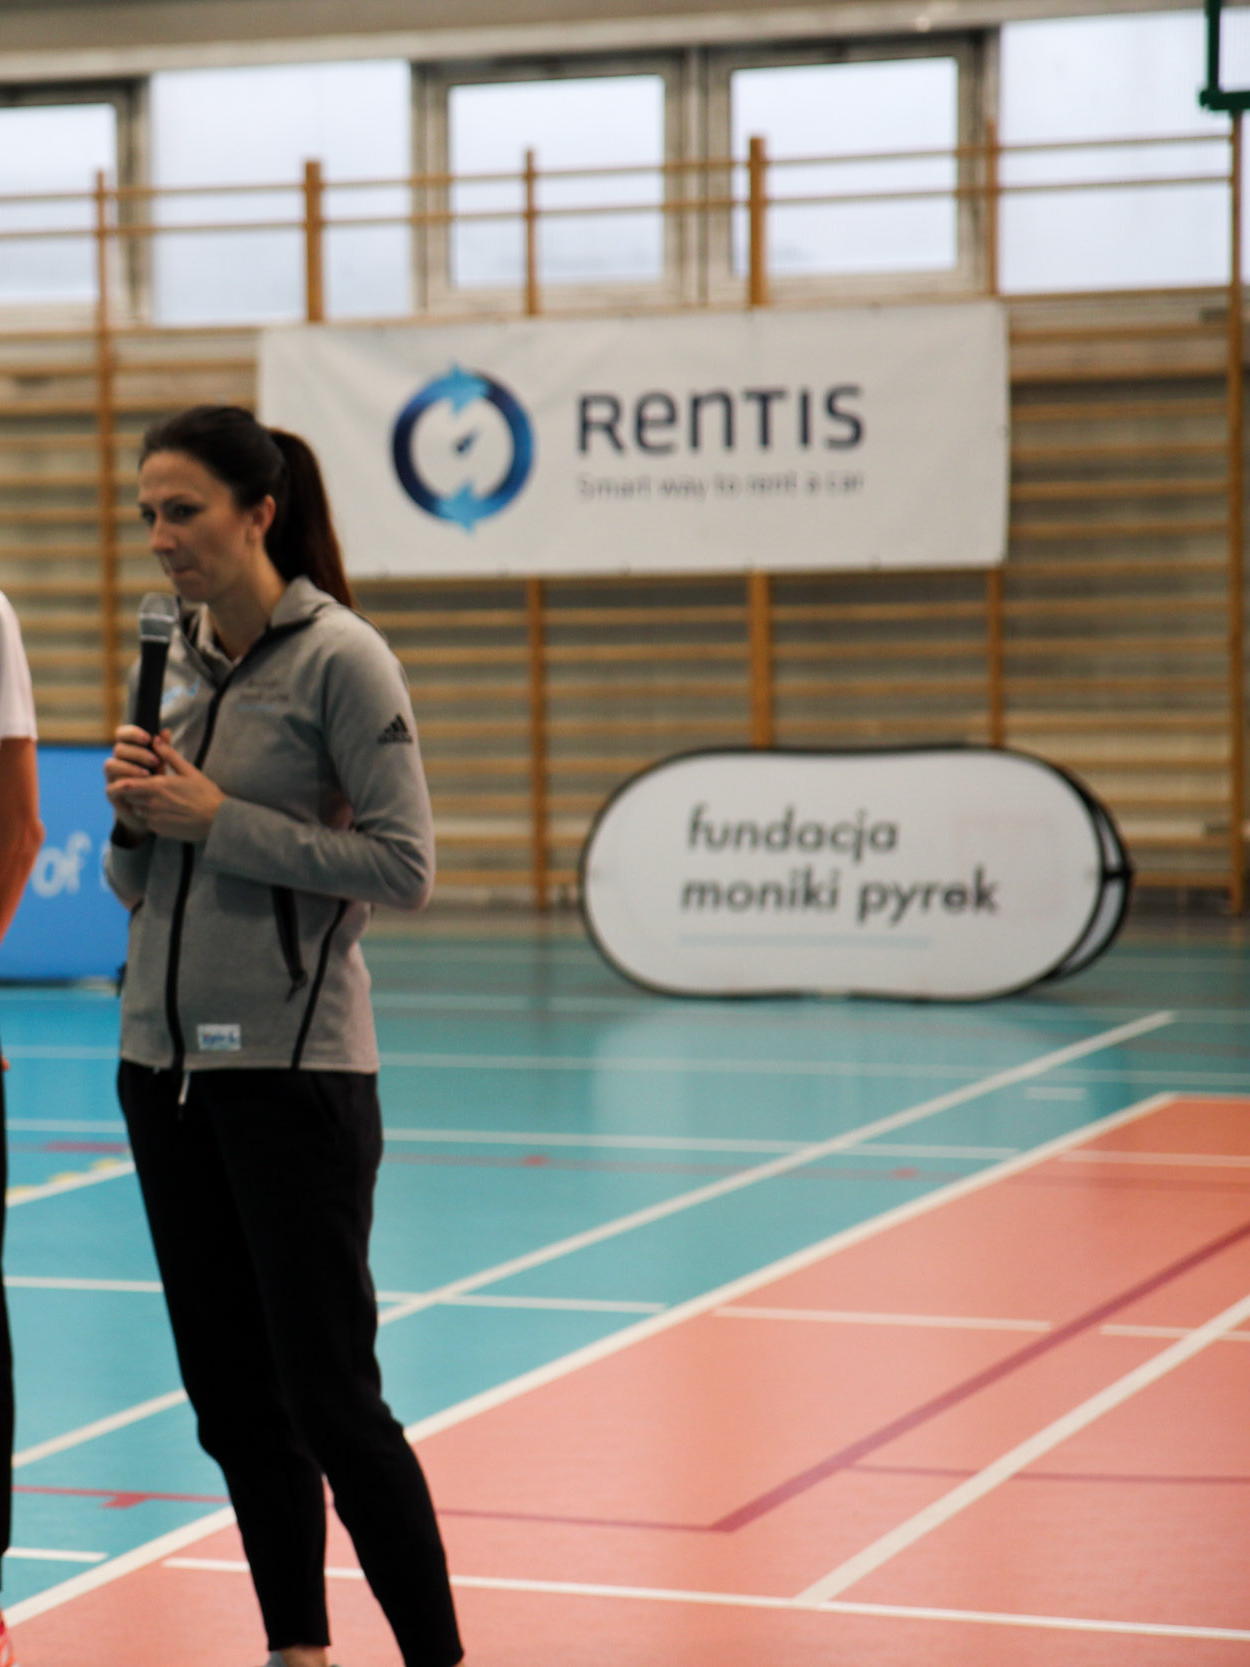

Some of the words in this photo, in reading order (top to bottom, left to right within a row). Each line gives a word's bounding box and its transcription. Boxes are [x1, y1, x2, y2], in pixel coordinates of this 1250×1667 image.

[579, 472, 650, 499] Smart
[659, 475, 707, 501] way
[715, 470, 740, 494] to
[689, 802, 899, 863] fundacja
[681, 865, 839, 912] moniki
[856, 864, 998, 926] pyrek
